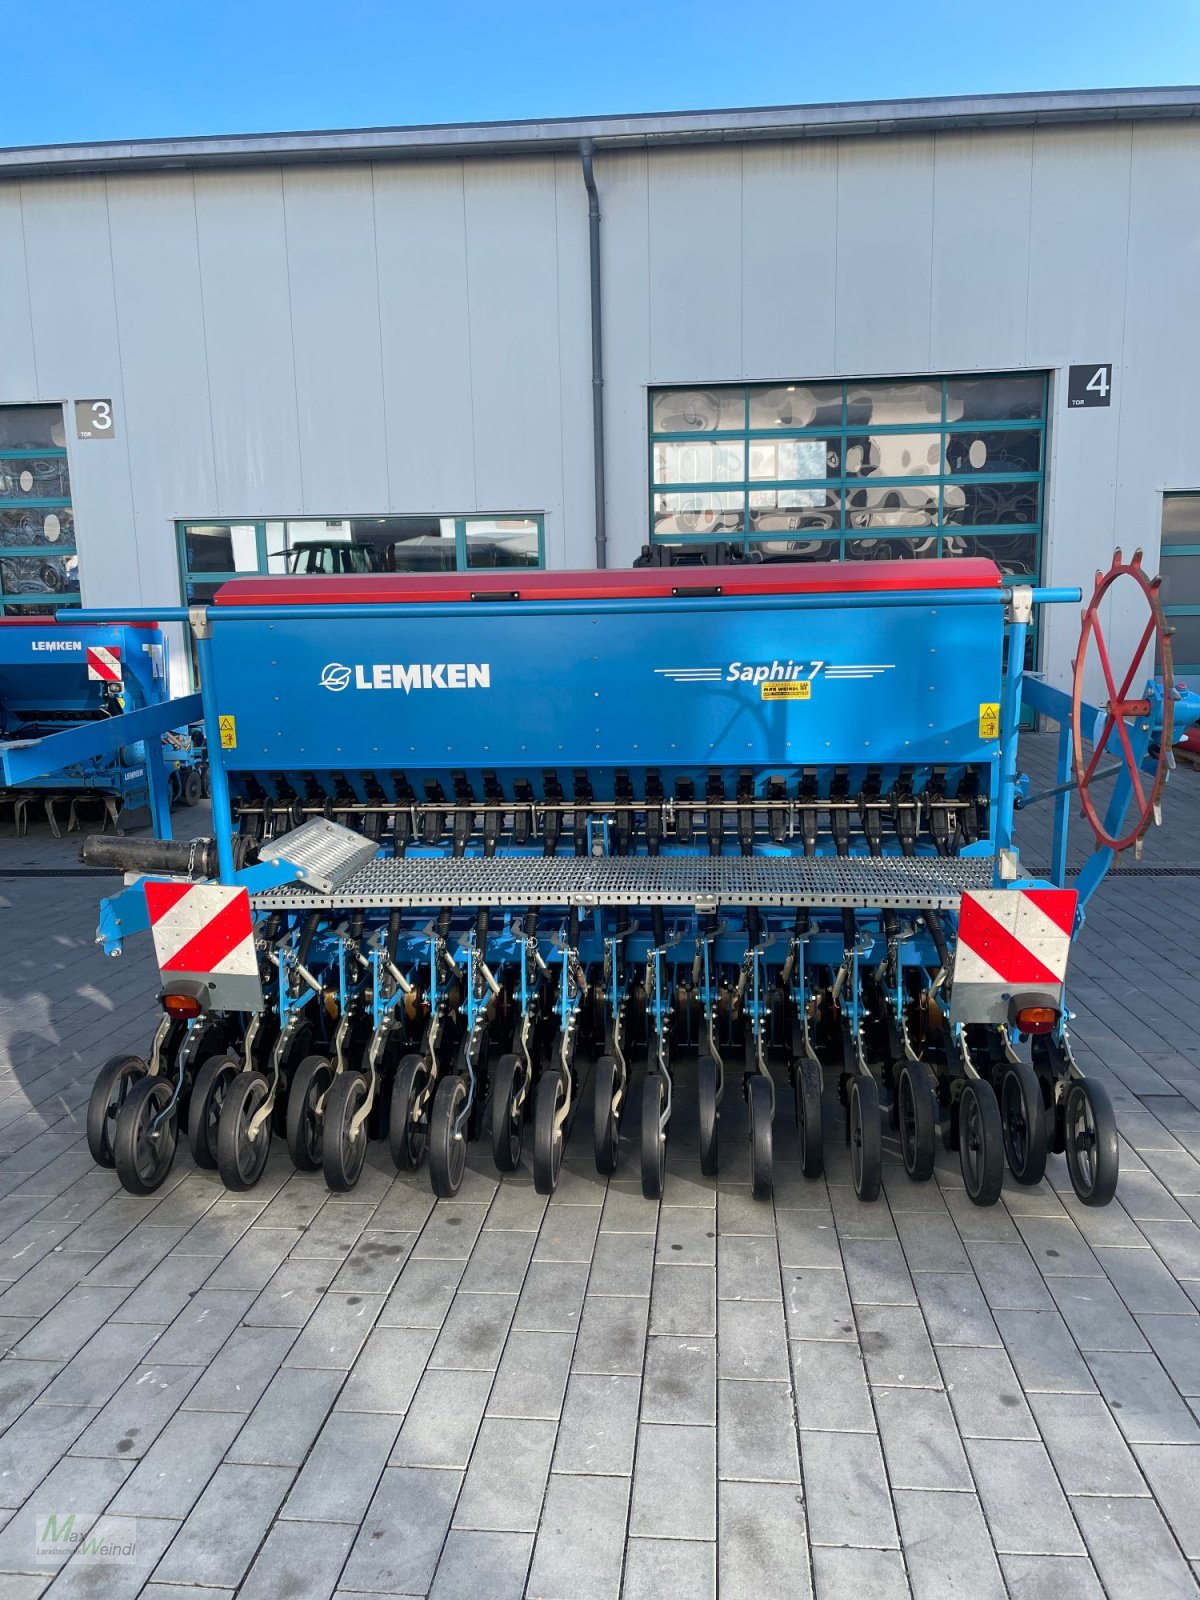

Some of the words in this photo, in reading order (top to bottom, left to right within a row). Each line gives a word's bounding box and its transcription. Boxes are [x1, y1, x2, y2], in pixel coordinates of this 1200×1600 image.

[1085, 367, 1110, 397] 4
[91, 401, 112, 430] 3
[31, 641, 82, 653] LEMKEN
[355, 663, 491, 696] LEMKEN
[726, 660, 804, 686] Saphir
[807, 660, 824, 680] 7
